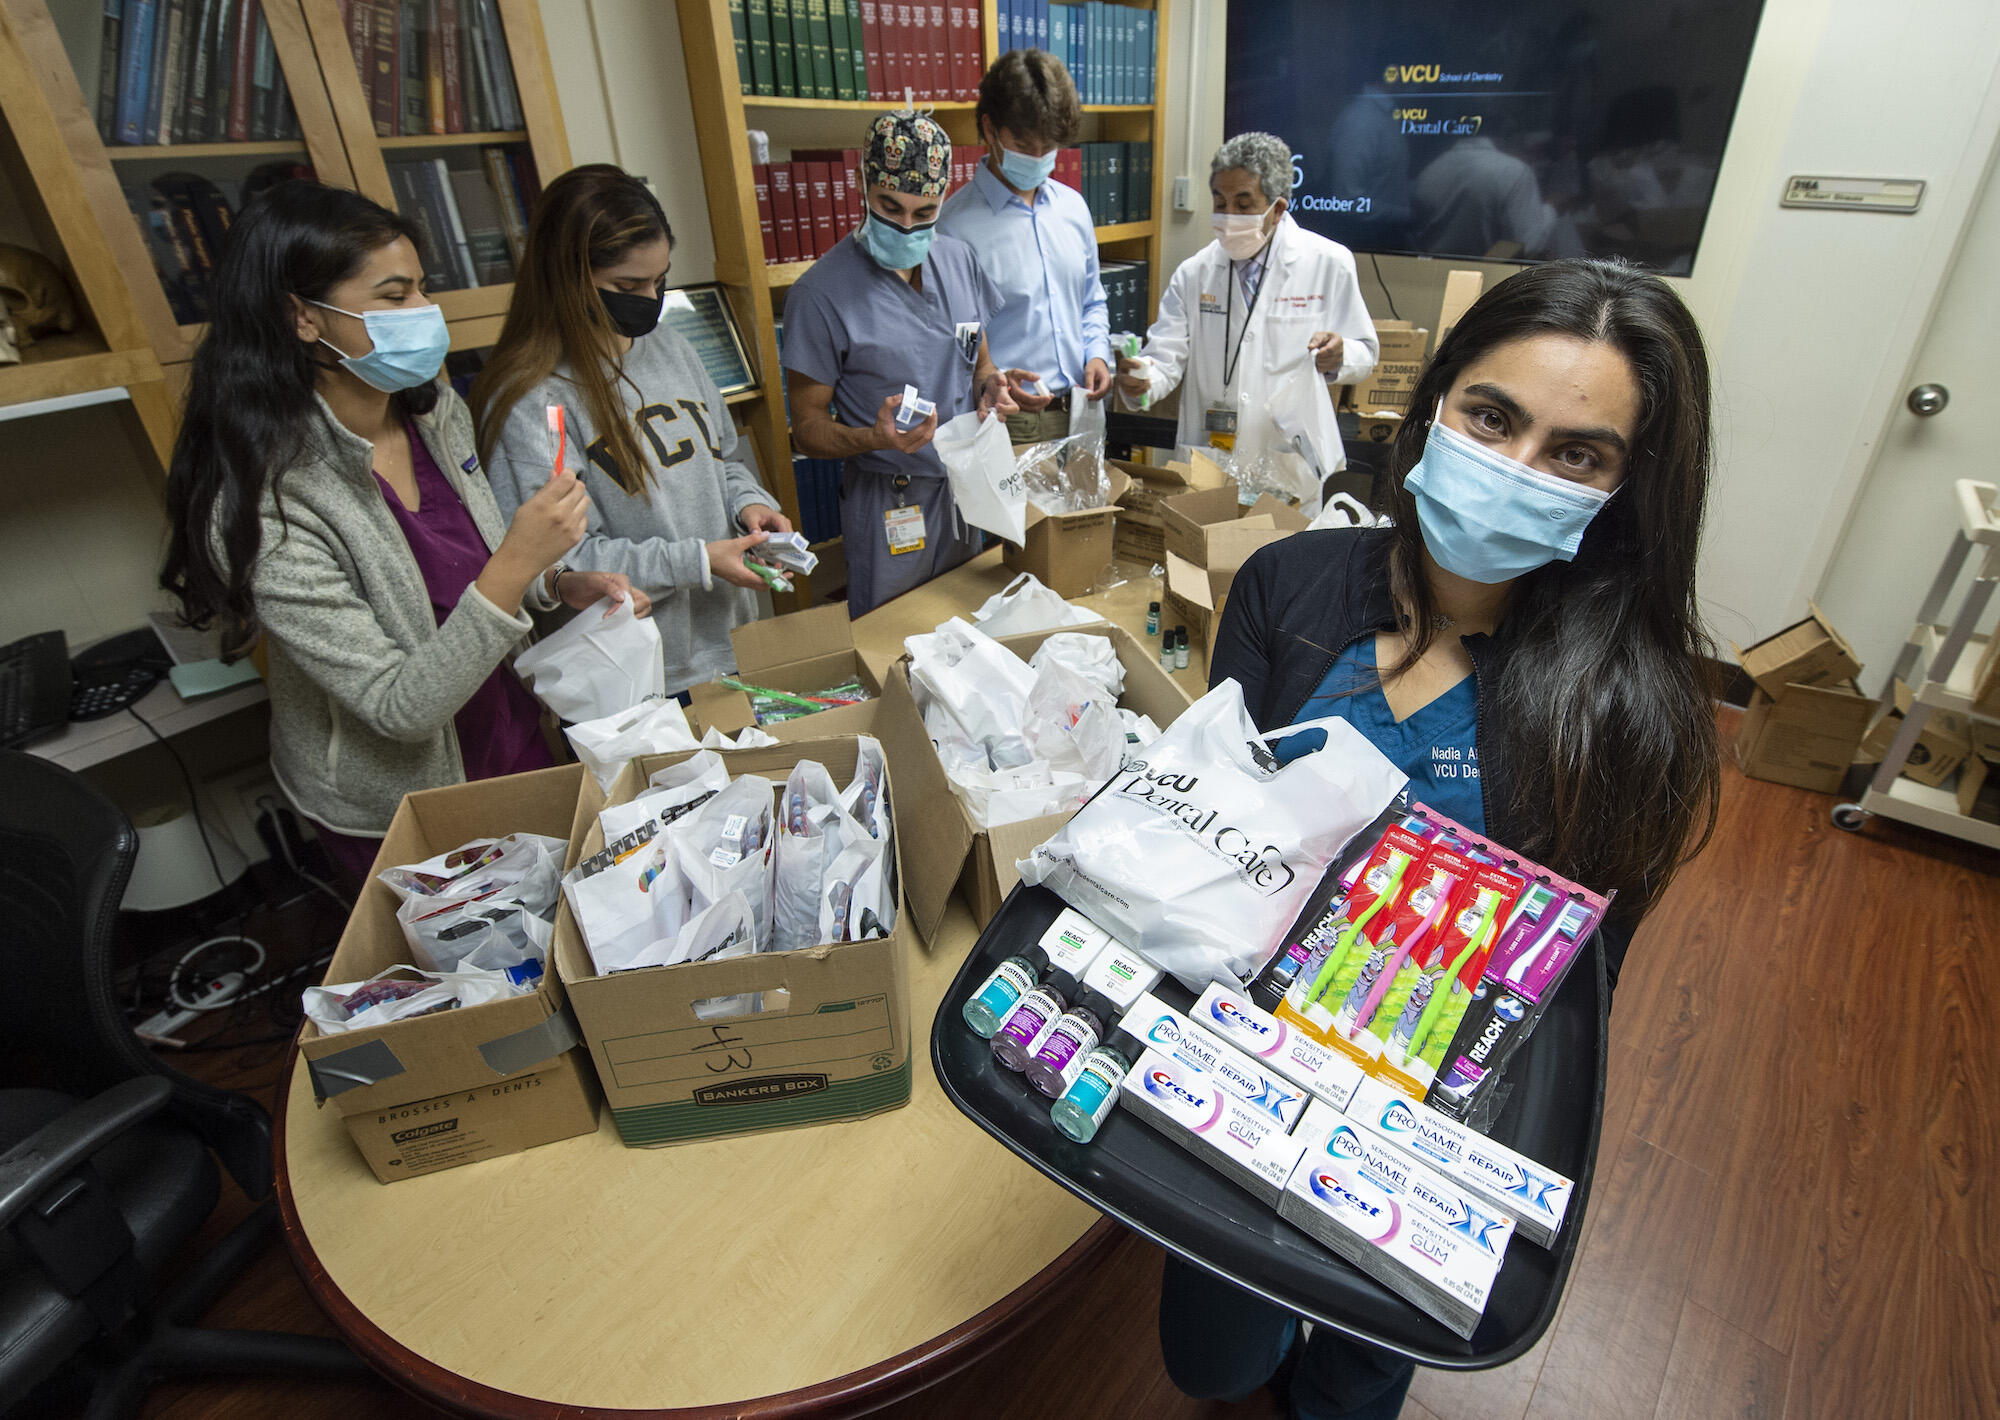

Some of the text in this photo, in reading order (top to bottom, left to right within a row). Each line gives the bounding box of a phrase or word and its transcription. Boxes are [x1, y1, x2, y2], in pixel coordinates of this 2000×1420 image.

[1400, 64, 1440, 83] VCU
[1440, 71, 1503, 82] School of Dentistry
[1402, 108, 1427, 120] VCU
[1401, 119, 1474, 134] Dental Care
[1302, 195, 1354, 212] October
[1356, 197, 1371, 213] 21
[1432, 746, 1461, 760] Nadia
[1433, 763, 1457, 778] VCU
[1121, 776, 1218, 834] Dental
[1214, 827, 1273, 887] Care
[1064, 930, 1086, 945] REACH
[1005, 967, 1029, 989] LISTERINE
[1114, 960, 1137, 976] REACH
[1505, 979, 1537, 1001] TOTAL CARE
[1029, 995, 1055, 1013] LISTERINE
[1063, 1018, 1089, 1037] LISTERINE
[1219, 1002, 1269, 1035] Crest
[1188, 1031, 1222, 1055] SENSODYNE
[1294, 1035, 1332, 1061] SENSITIVE
[1468, 1015, 1507, 1064] REACH
[1090, 1057, 1120, 1079] LISTERINE
[1292, 1047, 1323, 1070] GUM
[703, 1079, 819, 1101] BANKERS BOX
[1153, 1072, 1205, 1107] Crest
[1219, 1065, 1257, 1093] REPAIR
[378, 1078, 542, 1124] BROSSES A DENTS
[395, 1120, 455, 1142] Colgate
[1232, 1107, 1272, 1136] SENSITIVE
[1424, 1116, 1466, 1141] SENSODYNE
[1229, 1121, 1261, 1146] GUM
[1370, 1144, 1412, 1172] SENSODYNE
[1469, 1153, 1514, 1183] REPAIR
[1319, 1175, 1380, 1217] Crest
[1413, 1186, 1457, 1218] REPAIR
[1410, 1219, 1458, 1252] SENSITIVE
[1411, 1233, 1449, 1263] GUM
